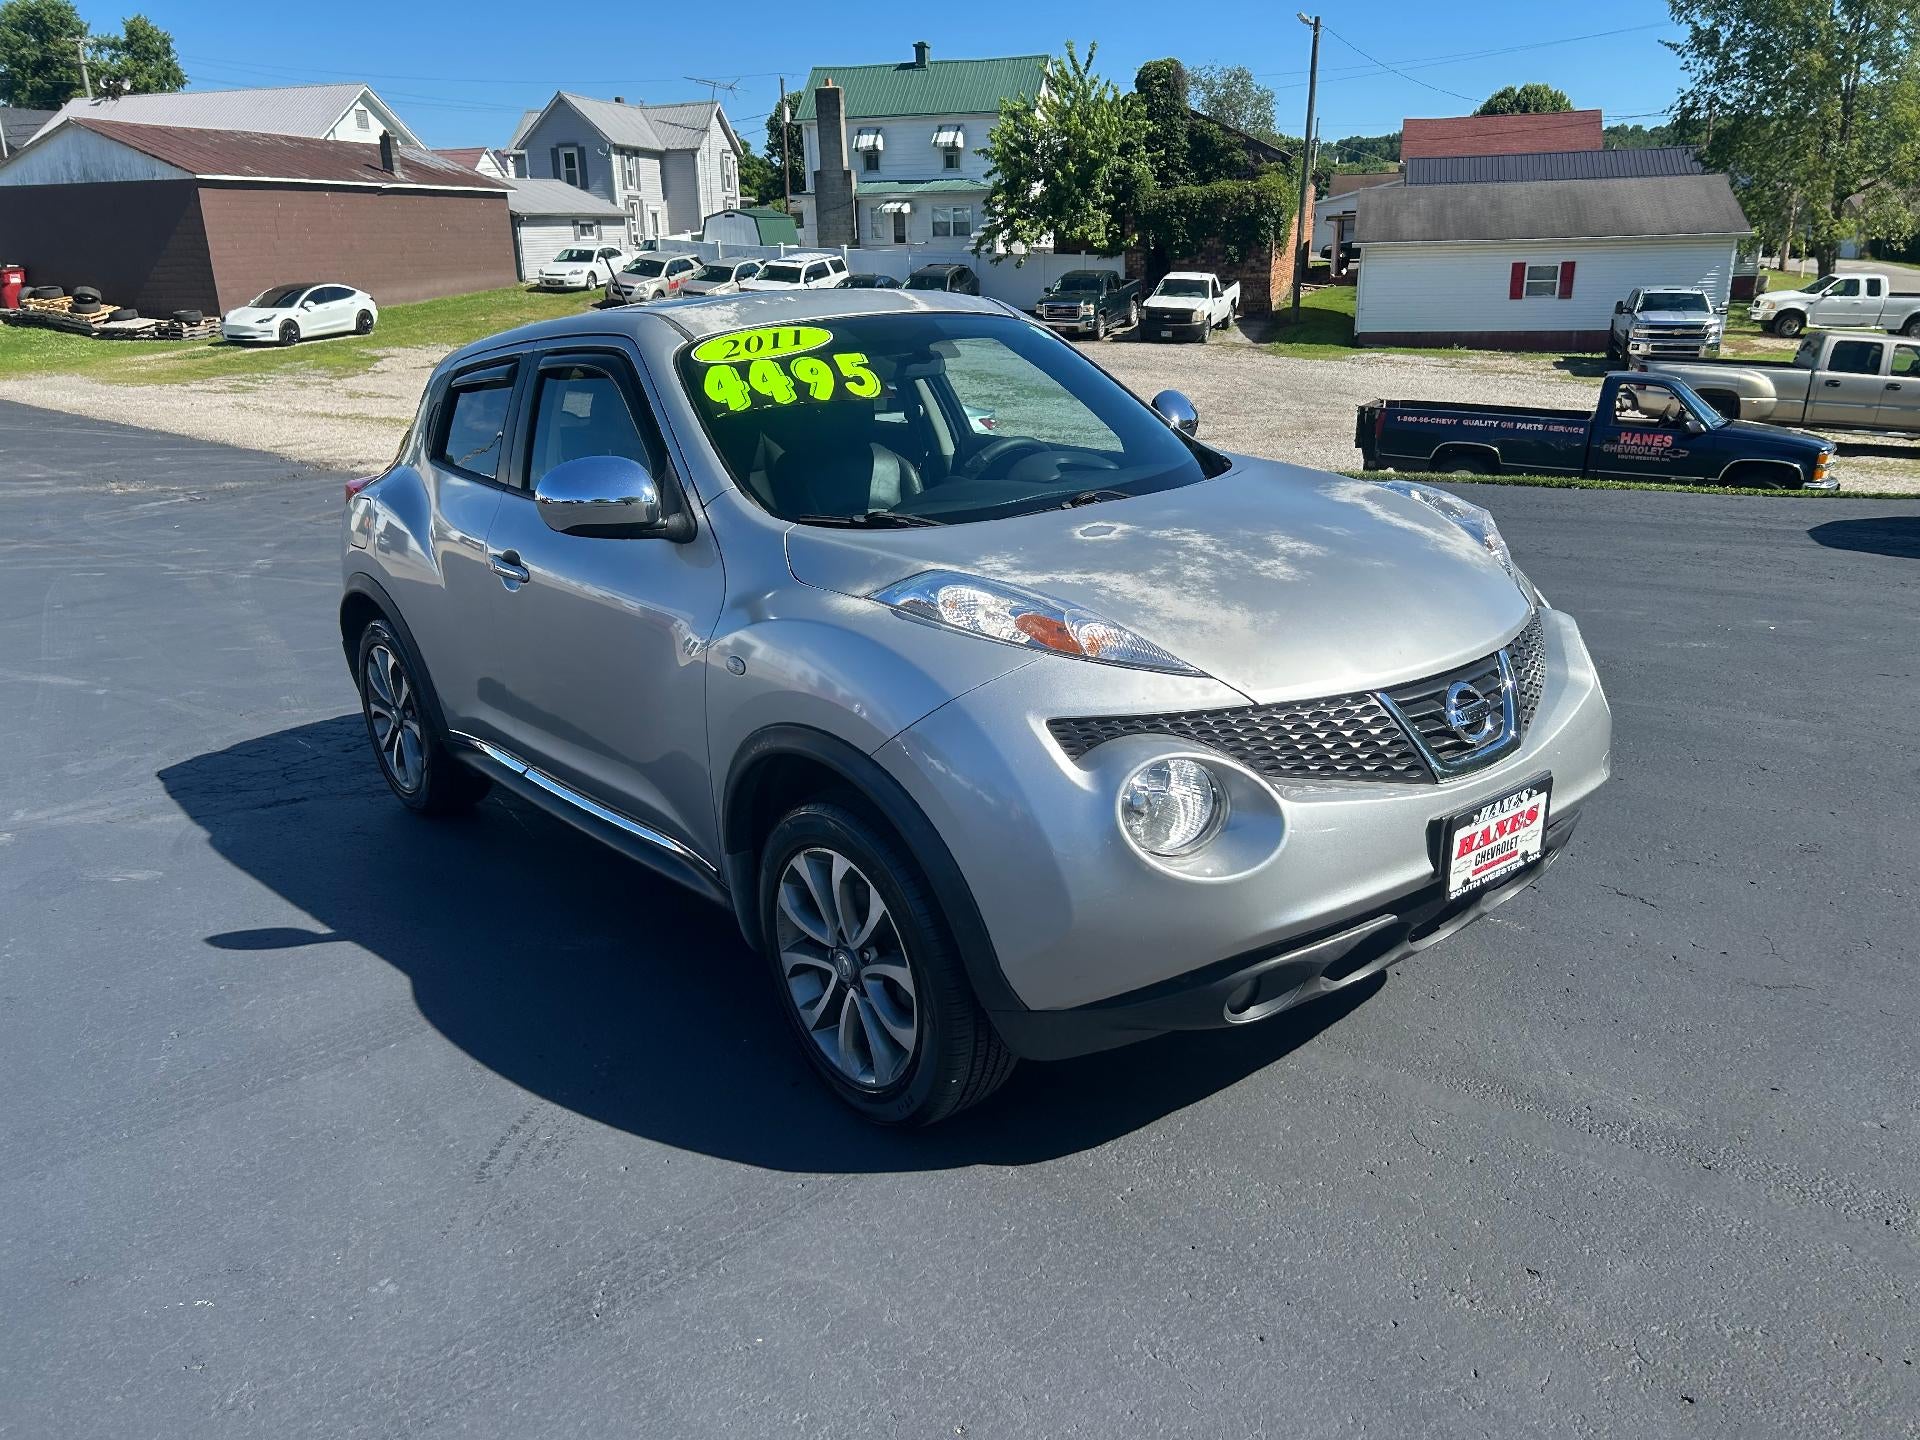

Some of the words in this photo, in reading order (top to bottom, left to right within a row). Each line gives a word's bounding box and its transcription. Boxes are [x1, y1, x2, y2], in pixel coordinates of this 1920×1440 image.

[723, 330, 803, 359] 2011
[704, 353, 882, 412] 4495
[1462, 419, 1499, 428] QUALITY
[1500, 421, 1514, 429] GM
[1602, 444, 1664, 456] CHEVROLET
[1619, 432, 1673, 447] HANES
[1479, 788, 1531, 823] HANES
[1455, 803, 1540, 861] HANES
[1474, 835, 1520, 867] CHEVROLET
[1449, 878, 1481, 900] SOUTH
